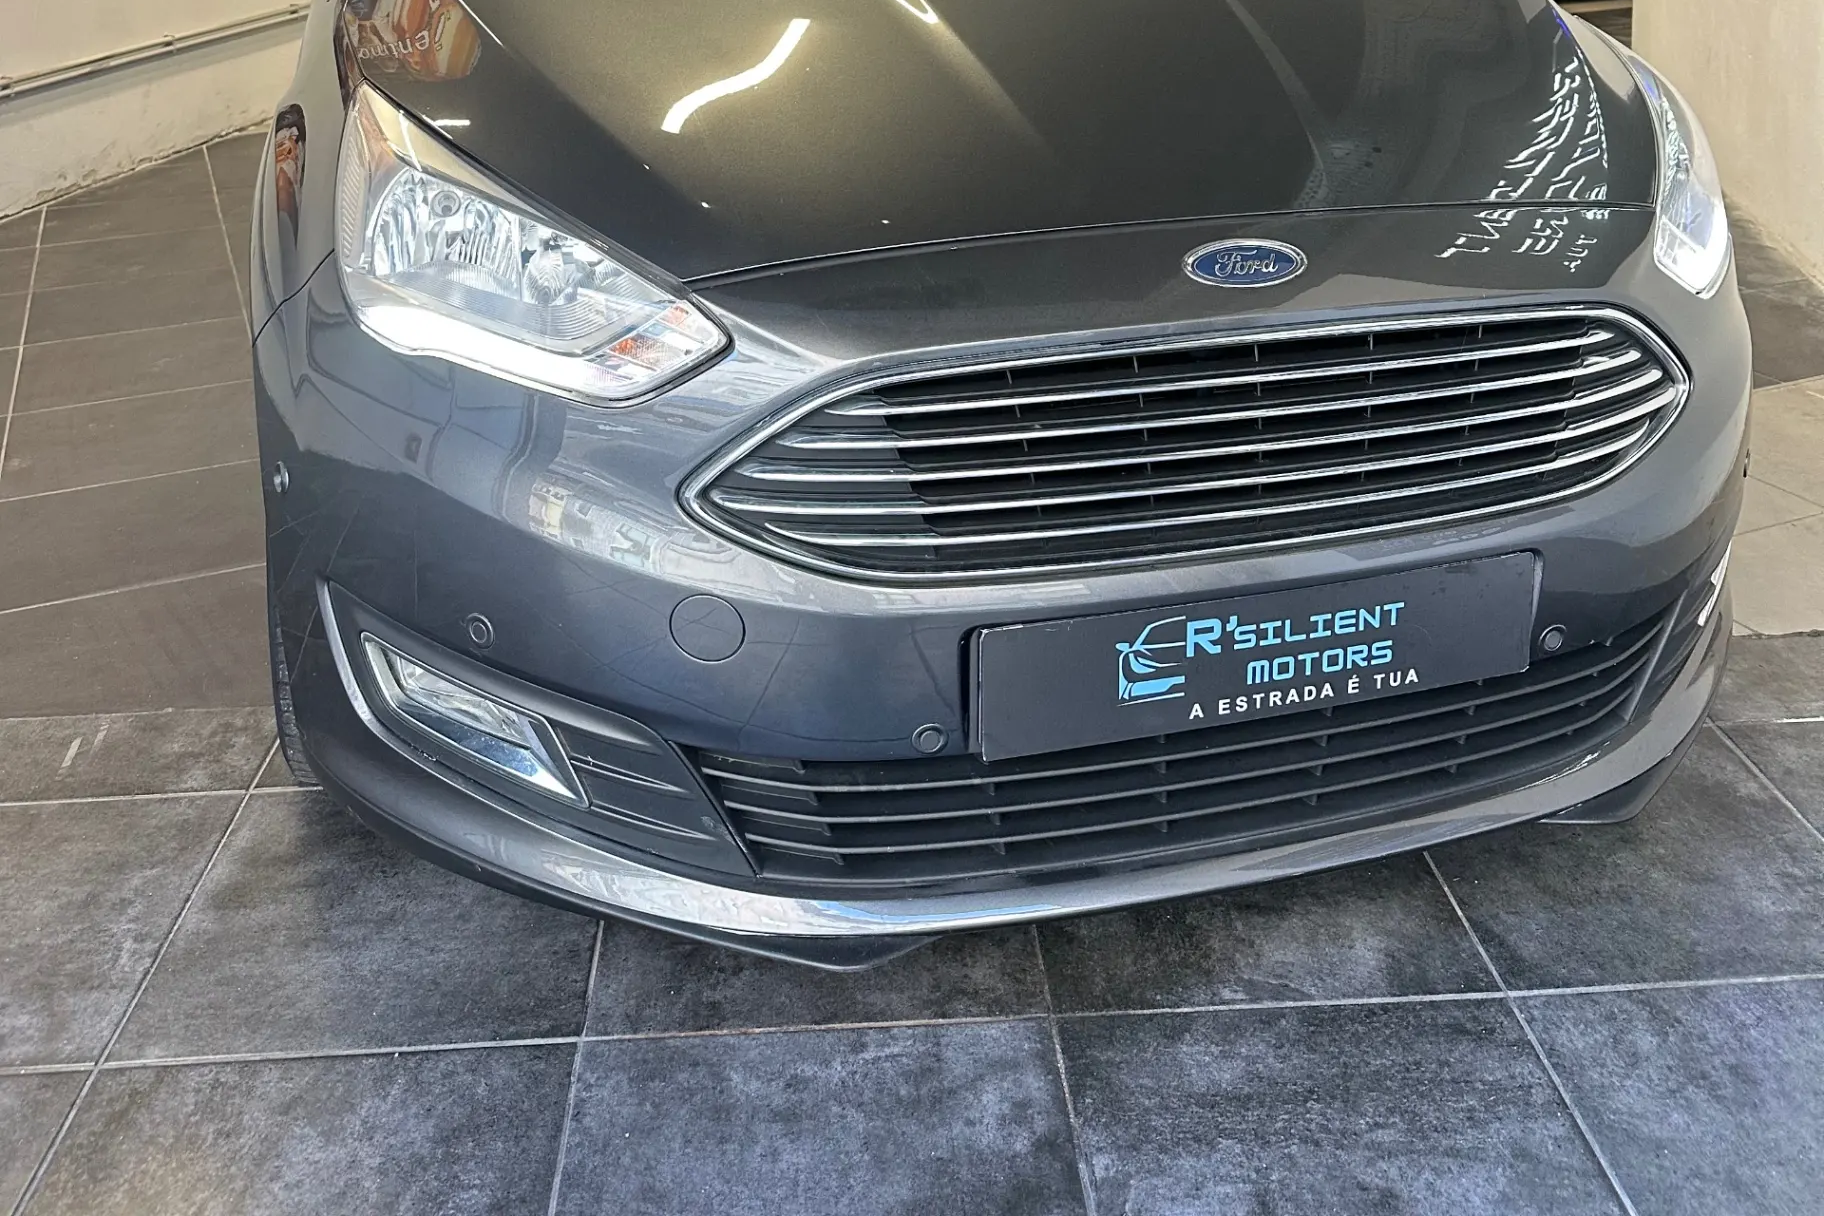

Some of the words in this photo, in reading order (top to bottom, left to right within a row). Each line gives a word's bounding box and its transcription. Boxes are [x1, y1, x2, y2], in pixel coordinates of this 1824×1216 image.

[1214, 249, 1279, 277] Ford
[1186, 601, 1405, 658] R'SILIENT
[1246, 639, 1393, 685] MOTORS
[1188, 703, 1205, 720] A
[1218, 682, 1335, 716] ESTRADA
[1347, 674, 1360, 694] É
[1373, 668, 1419, 690] TUA
